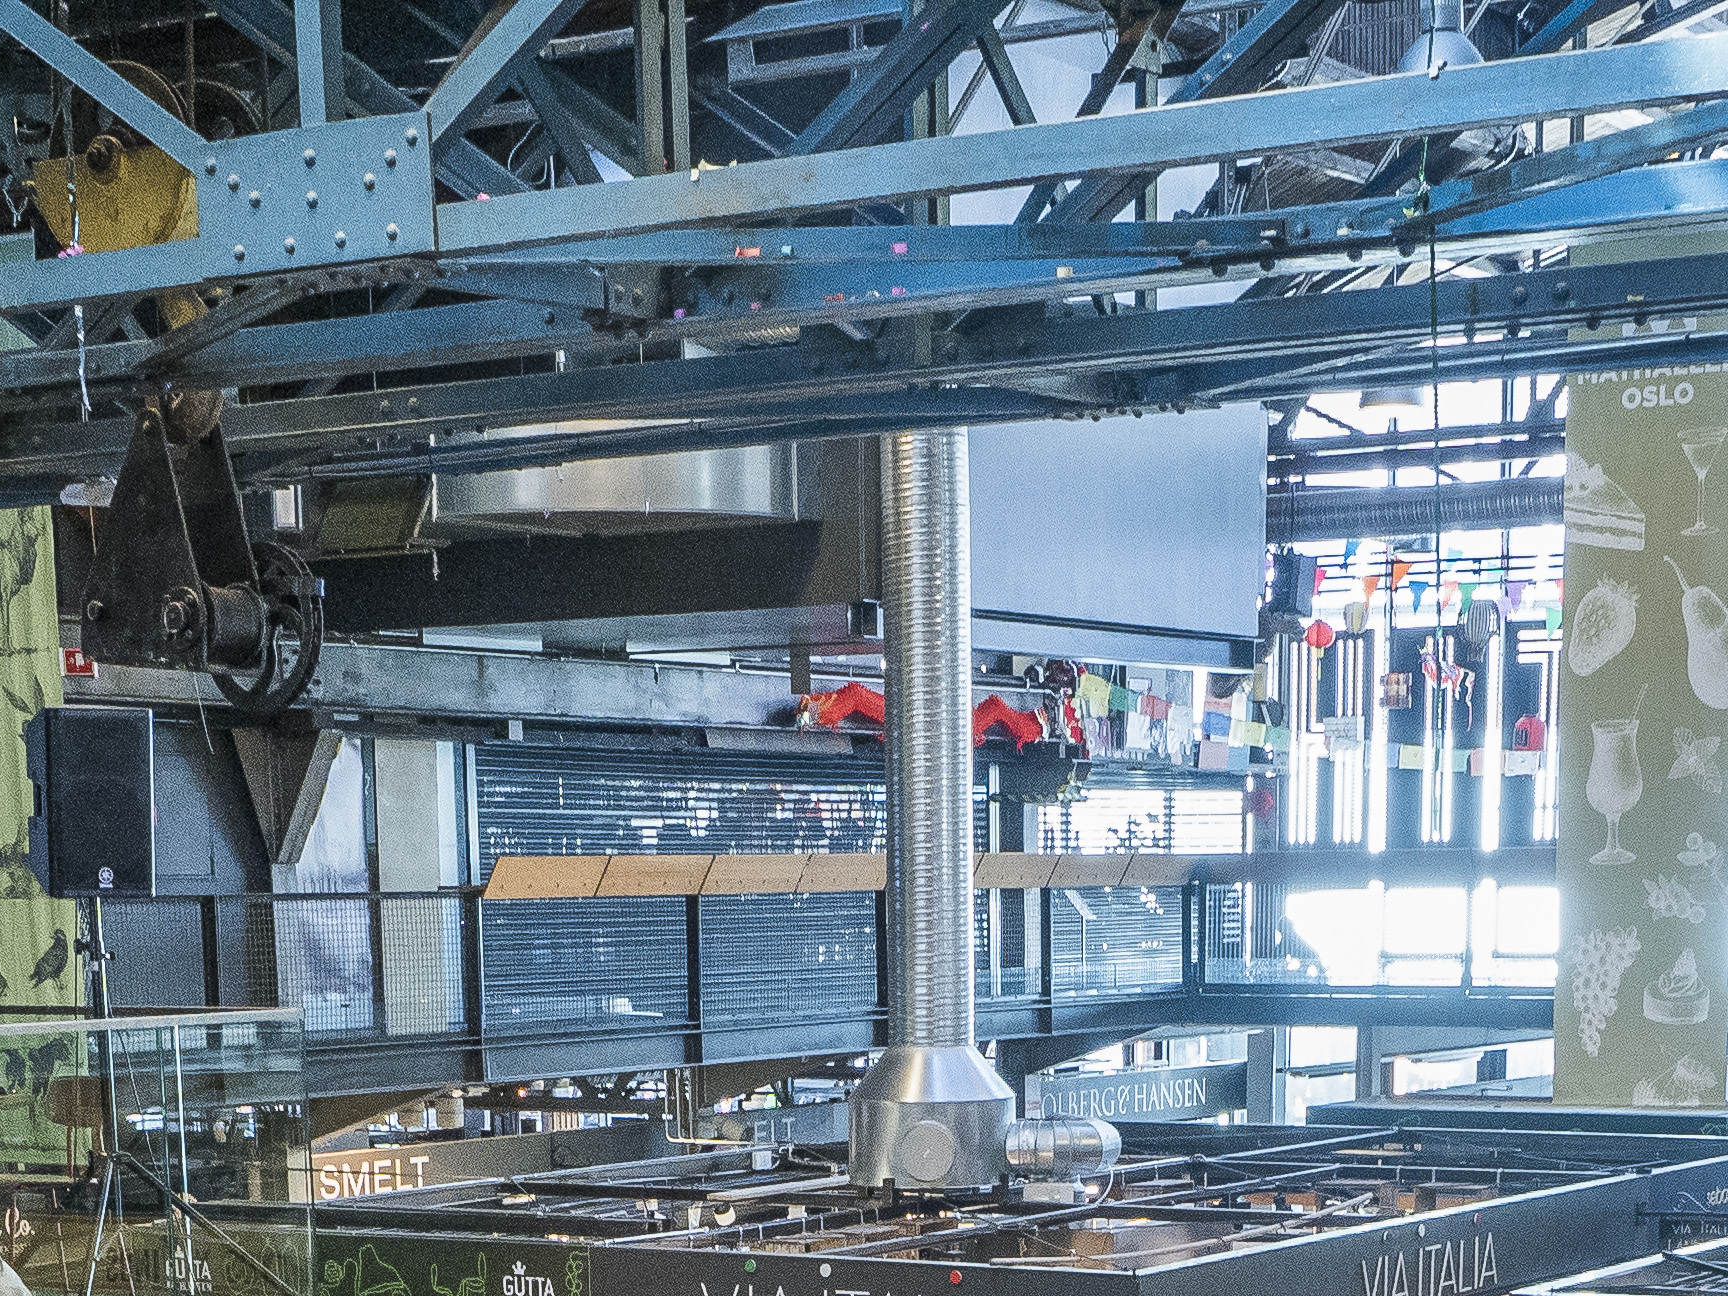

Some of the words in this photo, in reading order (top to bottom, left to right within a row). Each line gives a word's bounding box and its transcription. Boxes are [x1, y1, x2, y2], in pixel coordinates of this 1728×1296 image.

[1620, 381, 1695, 407] OSLO
[1041, 1085, 1115, 1119] OLBERG
[1133, 1077, 1208, 1112] HANSEN
[319, 1155, 430, 1201] SMELT
